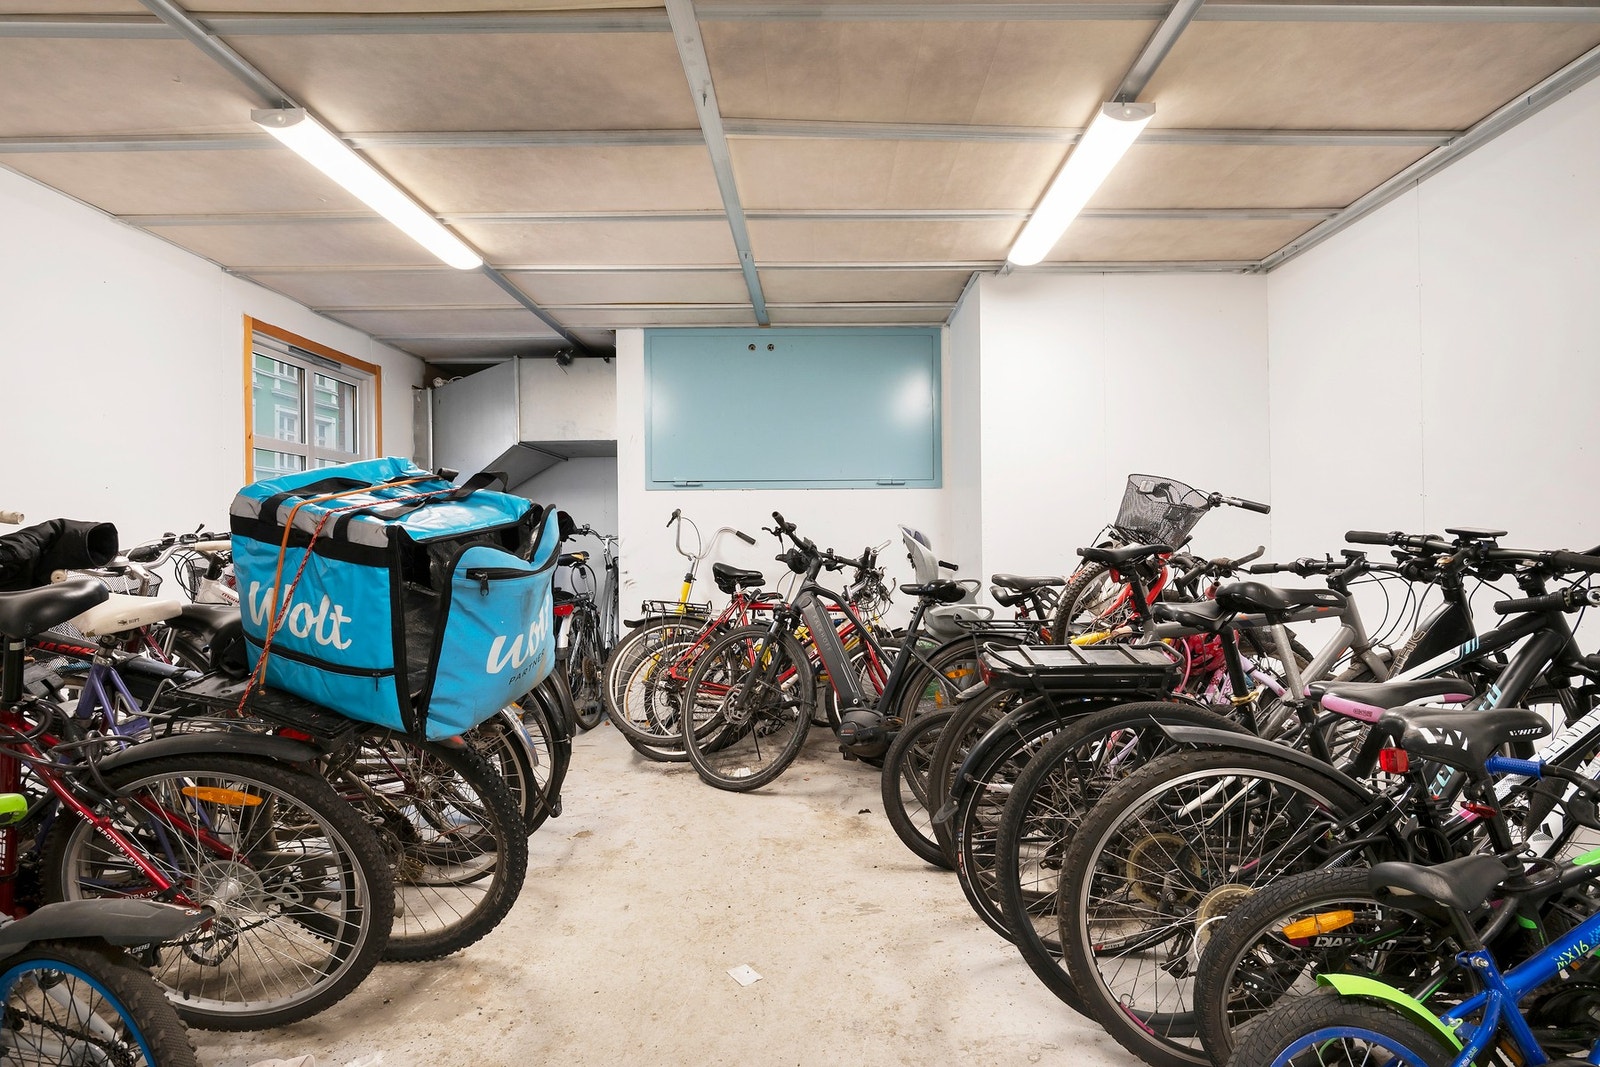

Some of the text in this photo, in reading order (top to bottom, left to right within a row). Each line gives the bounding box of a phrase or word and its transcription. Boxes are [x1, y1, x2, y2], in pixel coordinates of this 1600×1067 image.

[249, 580, 353, 650] Wolt
[508, 648, 545, 685] PARTNE
[1508, 726, 1544, 737] WHITE
[96, 826, 125, 853] SPORTS
[123, 852, 146, 876] LEVEL
[1555, 940, 1590, 970] MX16
